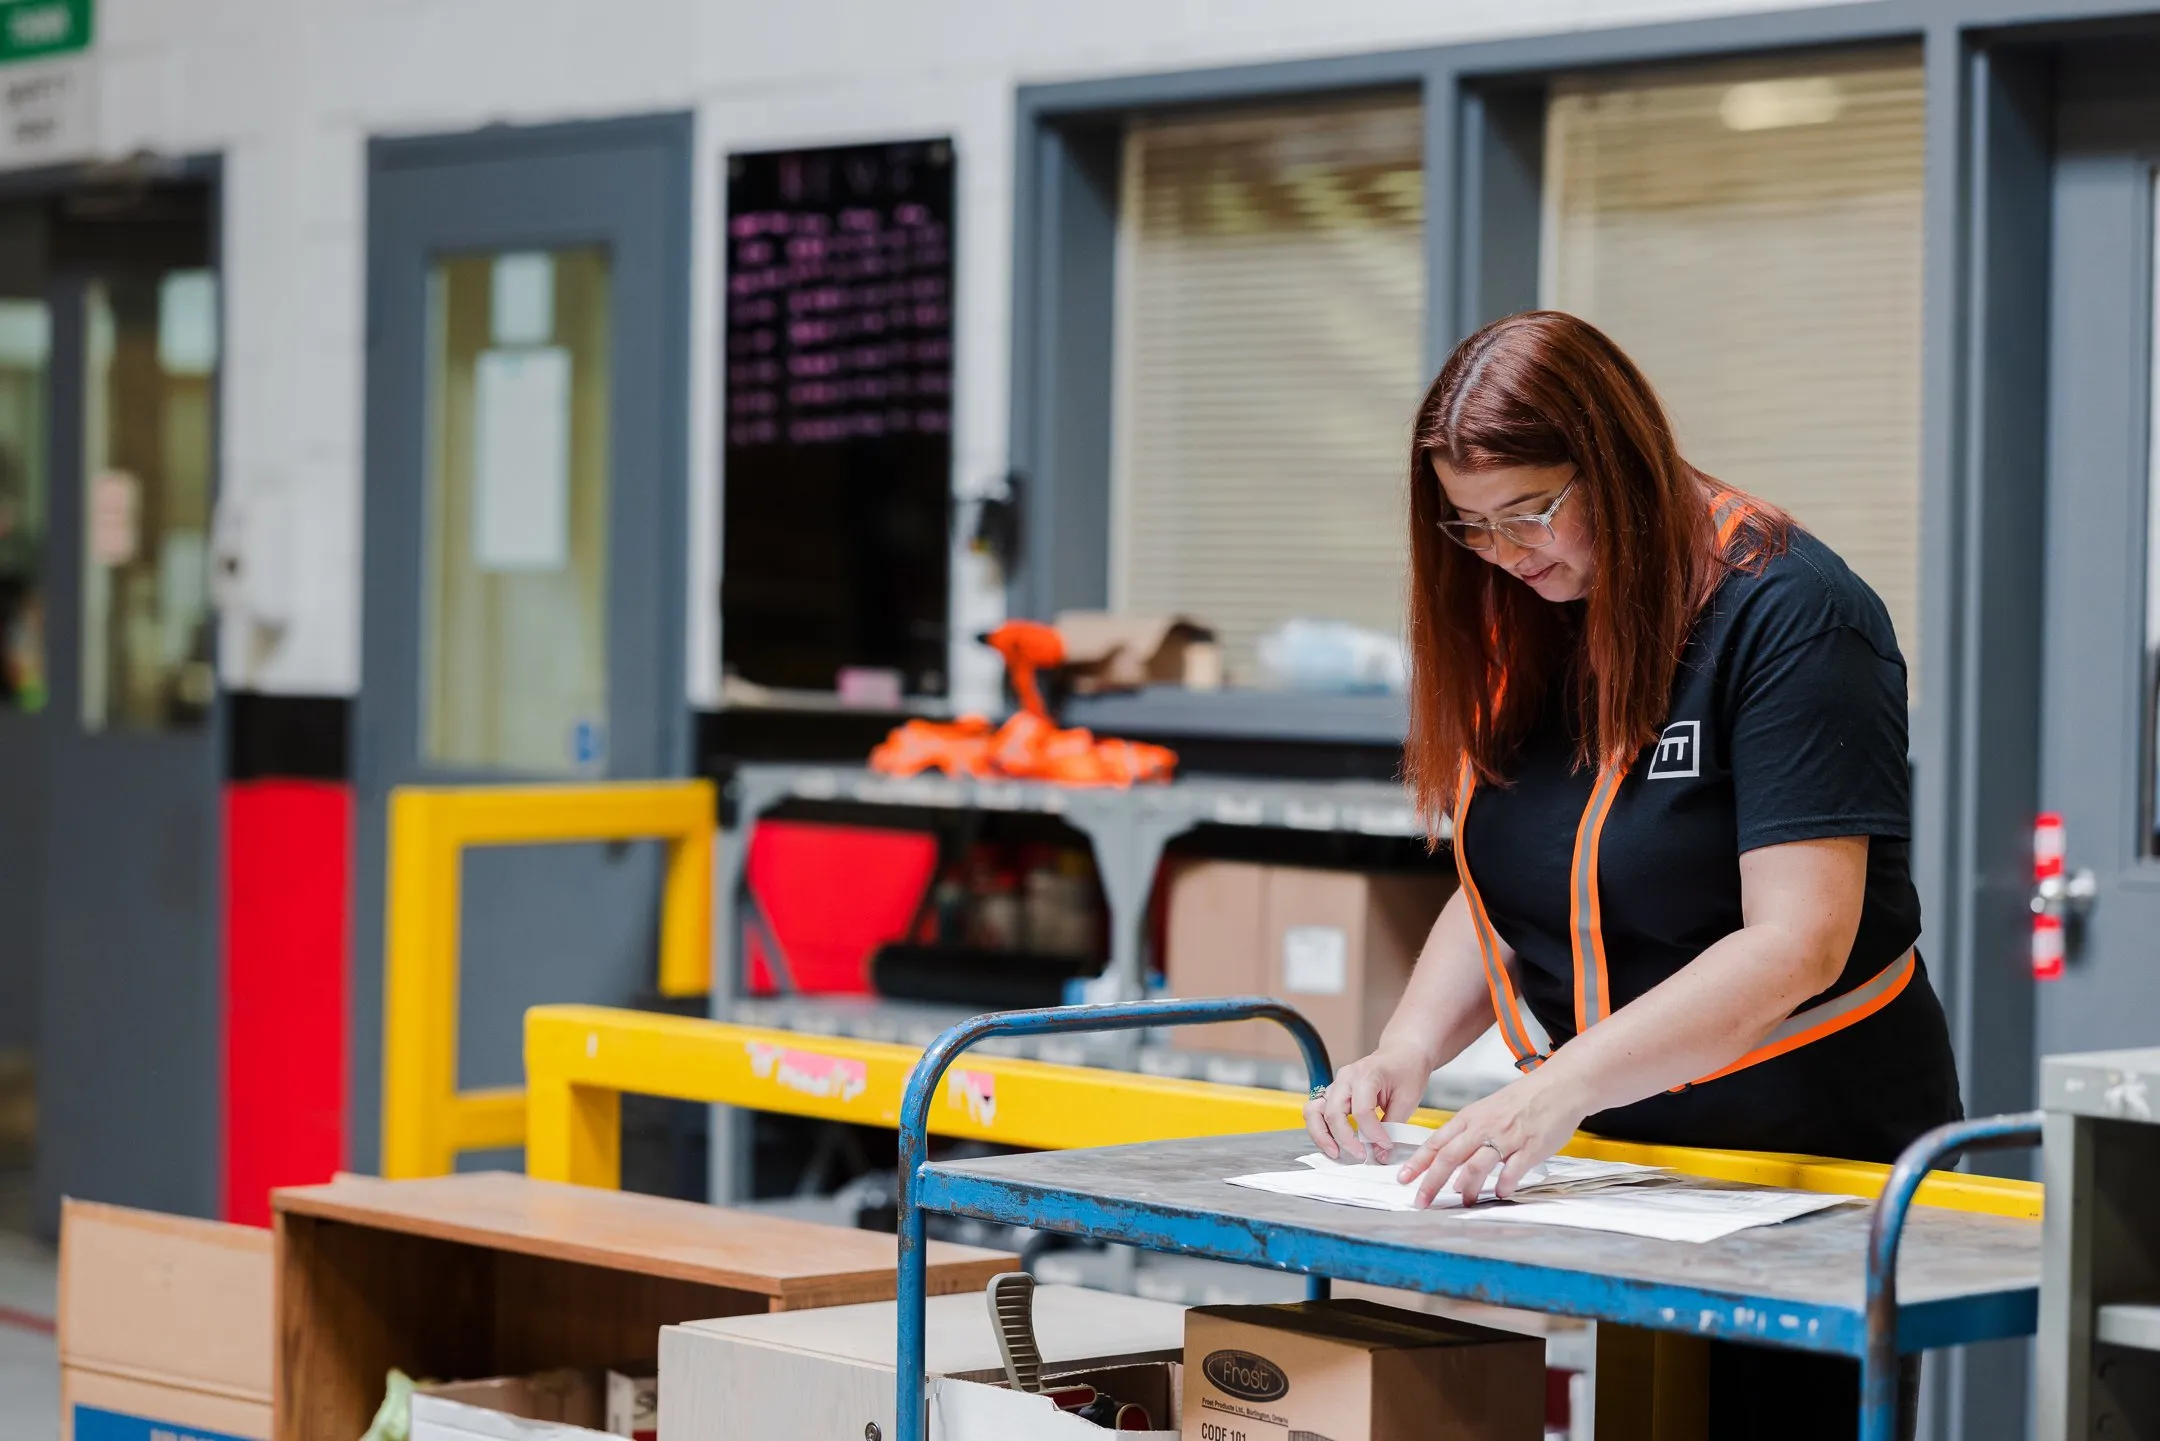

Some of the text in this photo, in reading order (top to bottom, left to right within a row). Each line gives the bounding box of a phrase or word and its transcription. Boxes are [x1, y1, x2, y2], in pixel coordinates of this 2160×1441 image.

[1202, 1397, 1214, 1406] Frost
[1214, 1400, 1235, 1411] Products
[1272, 1414, 1289, 1423] Ontario
[1202, 1423, 1227, 1441] CODE
